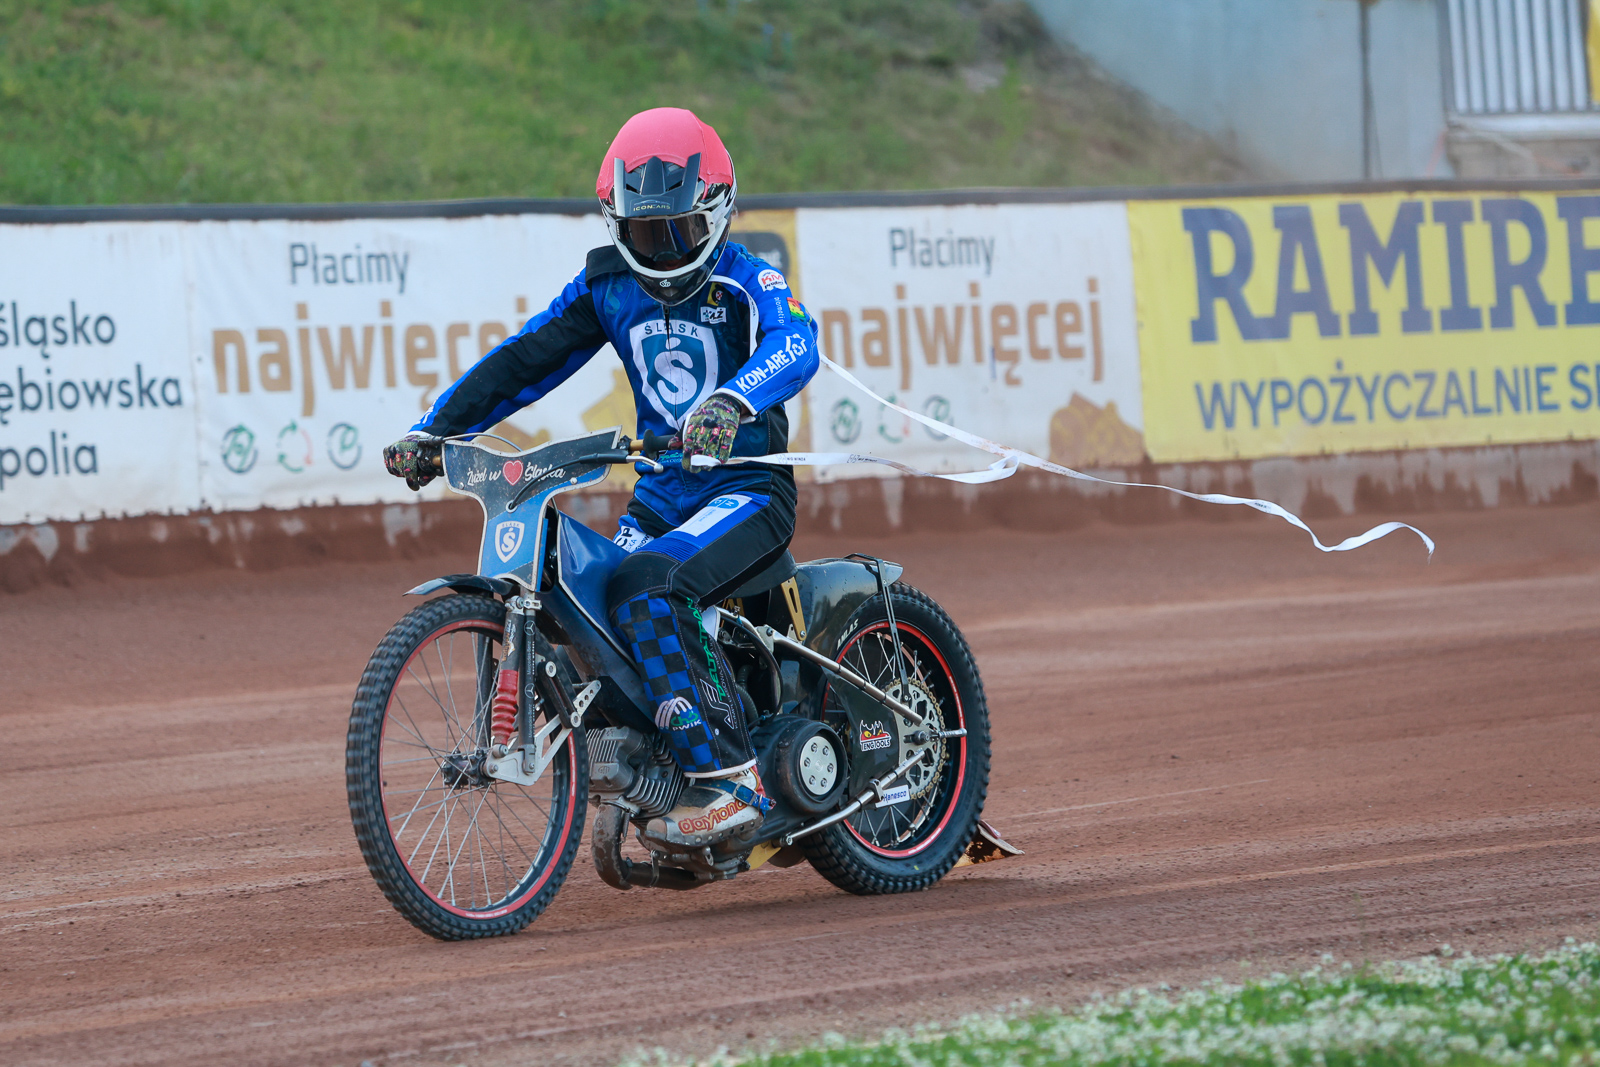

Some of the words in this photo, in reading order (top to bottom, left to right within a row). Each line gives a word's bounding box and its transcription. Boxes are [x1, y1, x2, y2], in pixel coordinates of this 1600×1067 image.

[289, 242, 410, 294] Płacimy
[889, 228, 996, 276] Płacimy
[1181, 196, 1600, 344] RAMIRE
[821, 277, 1104, 391] najwięcej
[1194, 359, 1560, 430] WYPOŻYCZALNIE
[1568, 363, 1600, 410] S
[687, 425, 732, 437] FIST
[0, 431, 99, 490] polia
[467, 466, 488, 486] Żużel
[488, 470, 502, 481] w
[678, 799, 747, 834] daytona
